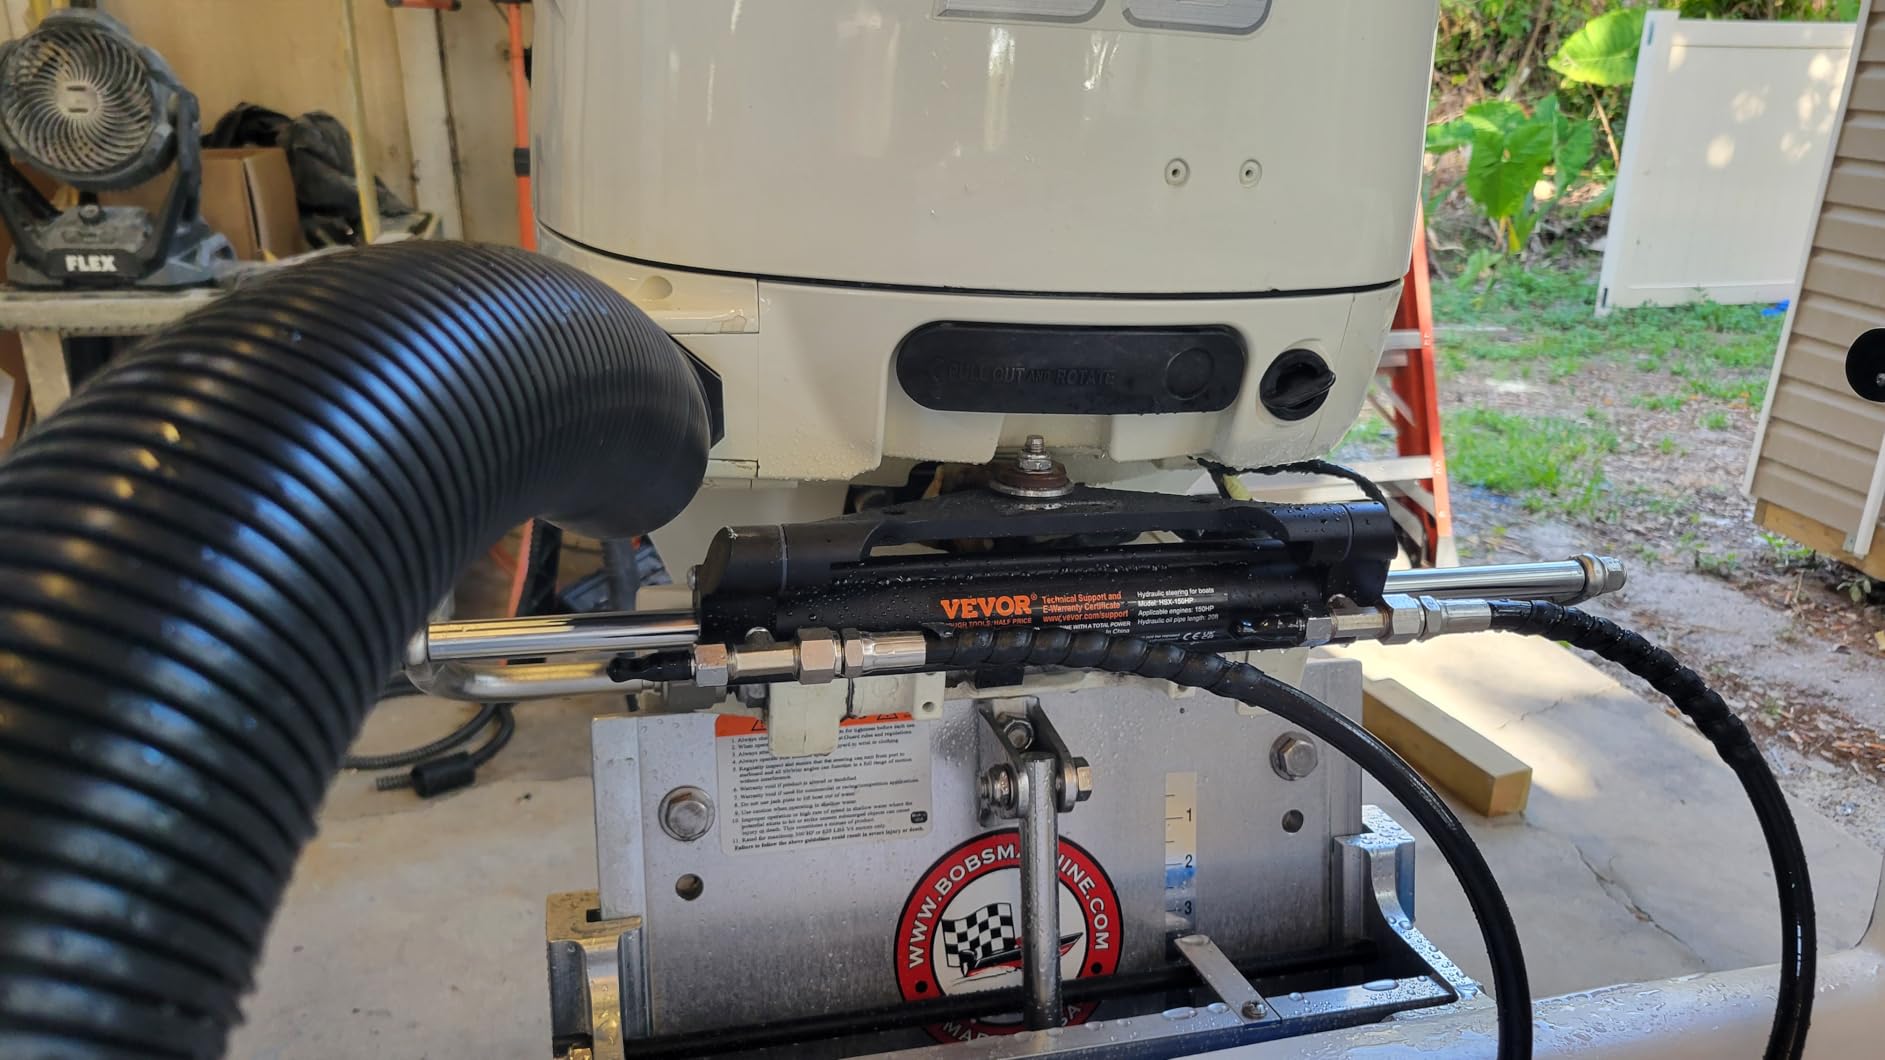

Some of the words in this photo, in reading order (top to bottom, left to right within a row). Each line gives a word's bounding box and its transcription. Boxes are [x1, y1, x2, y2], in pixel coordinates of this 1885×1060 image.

[65, 255, 117, 272] FLEX
[992, 367, 1025, 384] OUT
[1055, 367, 1117, 384] ROTATE
[1042, 594, 1077, 604] Technical
[1078, 592, 1107, 604] Support
[1108, 591, 1122, 600] and
[1137, 590, 1164, 599] Hydraulic
[1165, 589, 1188, 597] steering
[1042, 603, 1083, 614] E-Warranty
[1084, 601, 1120, 611] Certificate
[1158, 597, 1194, 606] HSX-150HP
[1042, 610, 1129, 623] www.vevor.com/support
[1138, 608, 1168, 617] Applicable
[1169, 607, 1193, 615] engines:
[993, 618, 1011, 626] HALF
[1012, 617, 1032, 625] PRICE
[1110, 620, 1131, 628] POWER
[1187, 615, 1206, 623] length:
[1186, 808, 1192, 822] 1
[1185, 854, 1193, 868] 2
[909, 844, 1110, 968] WWW.BOBSMINE.COM
[1184, 900, 1192, 915] 3
